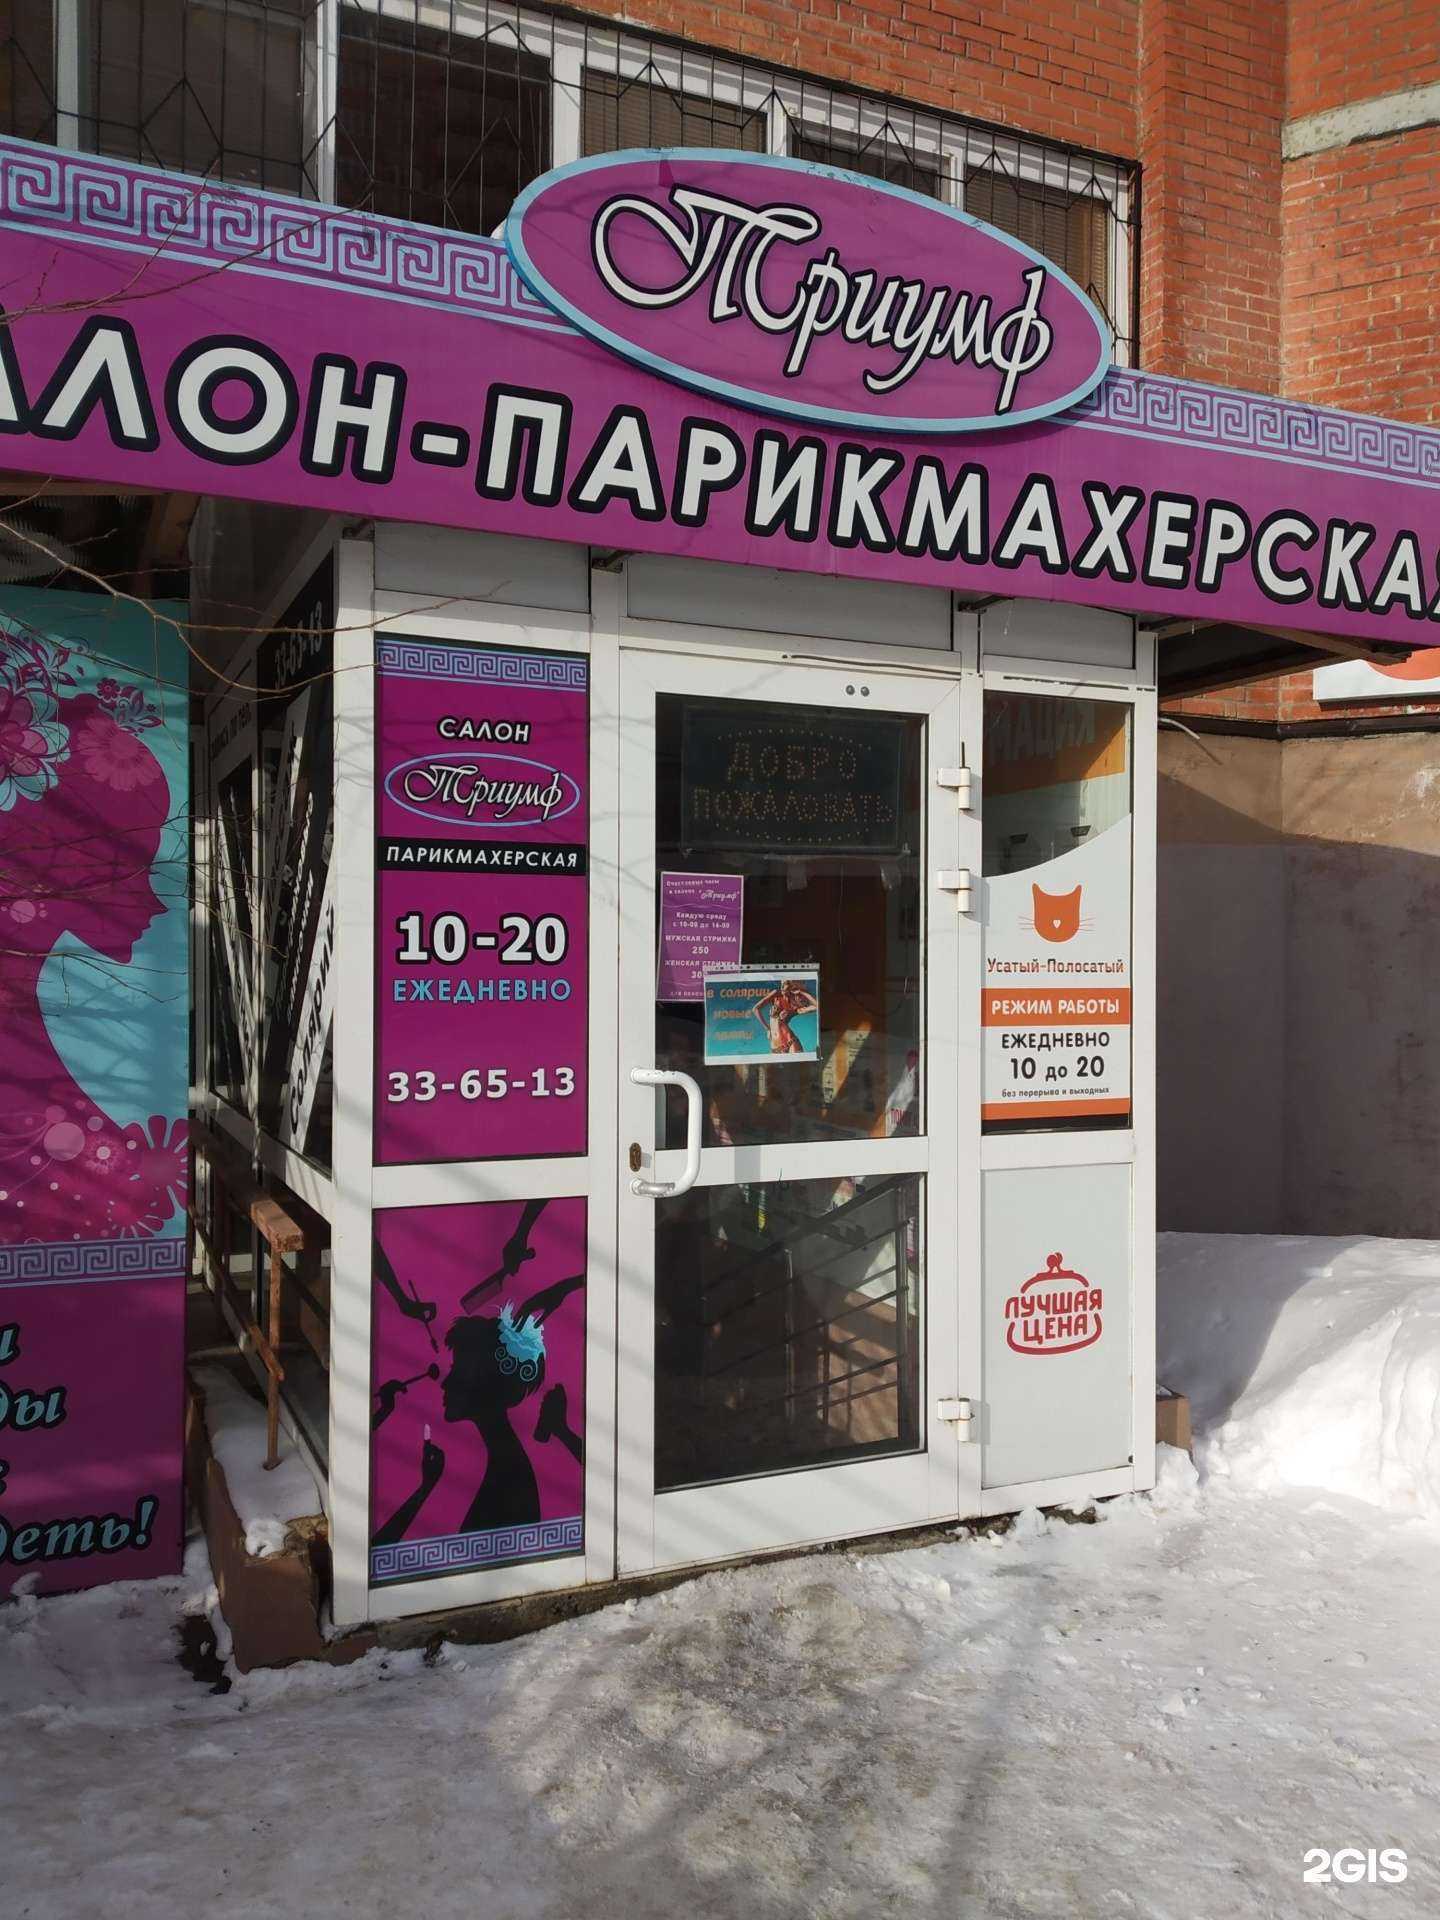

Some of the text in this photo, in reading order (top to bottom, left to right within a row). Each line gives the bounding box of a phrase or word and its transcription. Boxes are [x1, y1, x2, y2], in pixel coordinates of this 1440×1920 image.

[590, 184, 1053, 415] Триумф
[0, 302, 1440, 622] ЛОН-ПАРИКМАХЕРСКА
[438, 718, 531, 744] САЛОН
[727, 742, 857, 781] ДОБРО
[403, 762, 563, 822] Триумф
[693, 788, 894, 823] ПОЖАЛОВАТЬ
[386, 845, 578, 869] ПАРИКМАХЕРСКАЯ
[395, 911, 569, 967] 10-20
[691, 946, 710, 954] 250
[987, 957, 1125, 974] Усатый-Полосатый
[393, 978, 573, 1004] ЕЖЕДНЕВНО
[991, 998, 1120, 1015] РЕЖИМ РАБОТЫ
[1001, 1032, 1110, 1051] ЕЖЕДНЕВНО
[1010, 1055, 1105, 1082] 10 до 20
[387, 1067, 576, 1102] 33-65-13
[1001, 1089, 1016, 1098] без
[1018, 1088, 1060, 1099] перерыва
[1004, 1288, 1102, 1319] ЛУЧШАЯ
[1023, 1313, 1088, 1345] ЦЕНА
